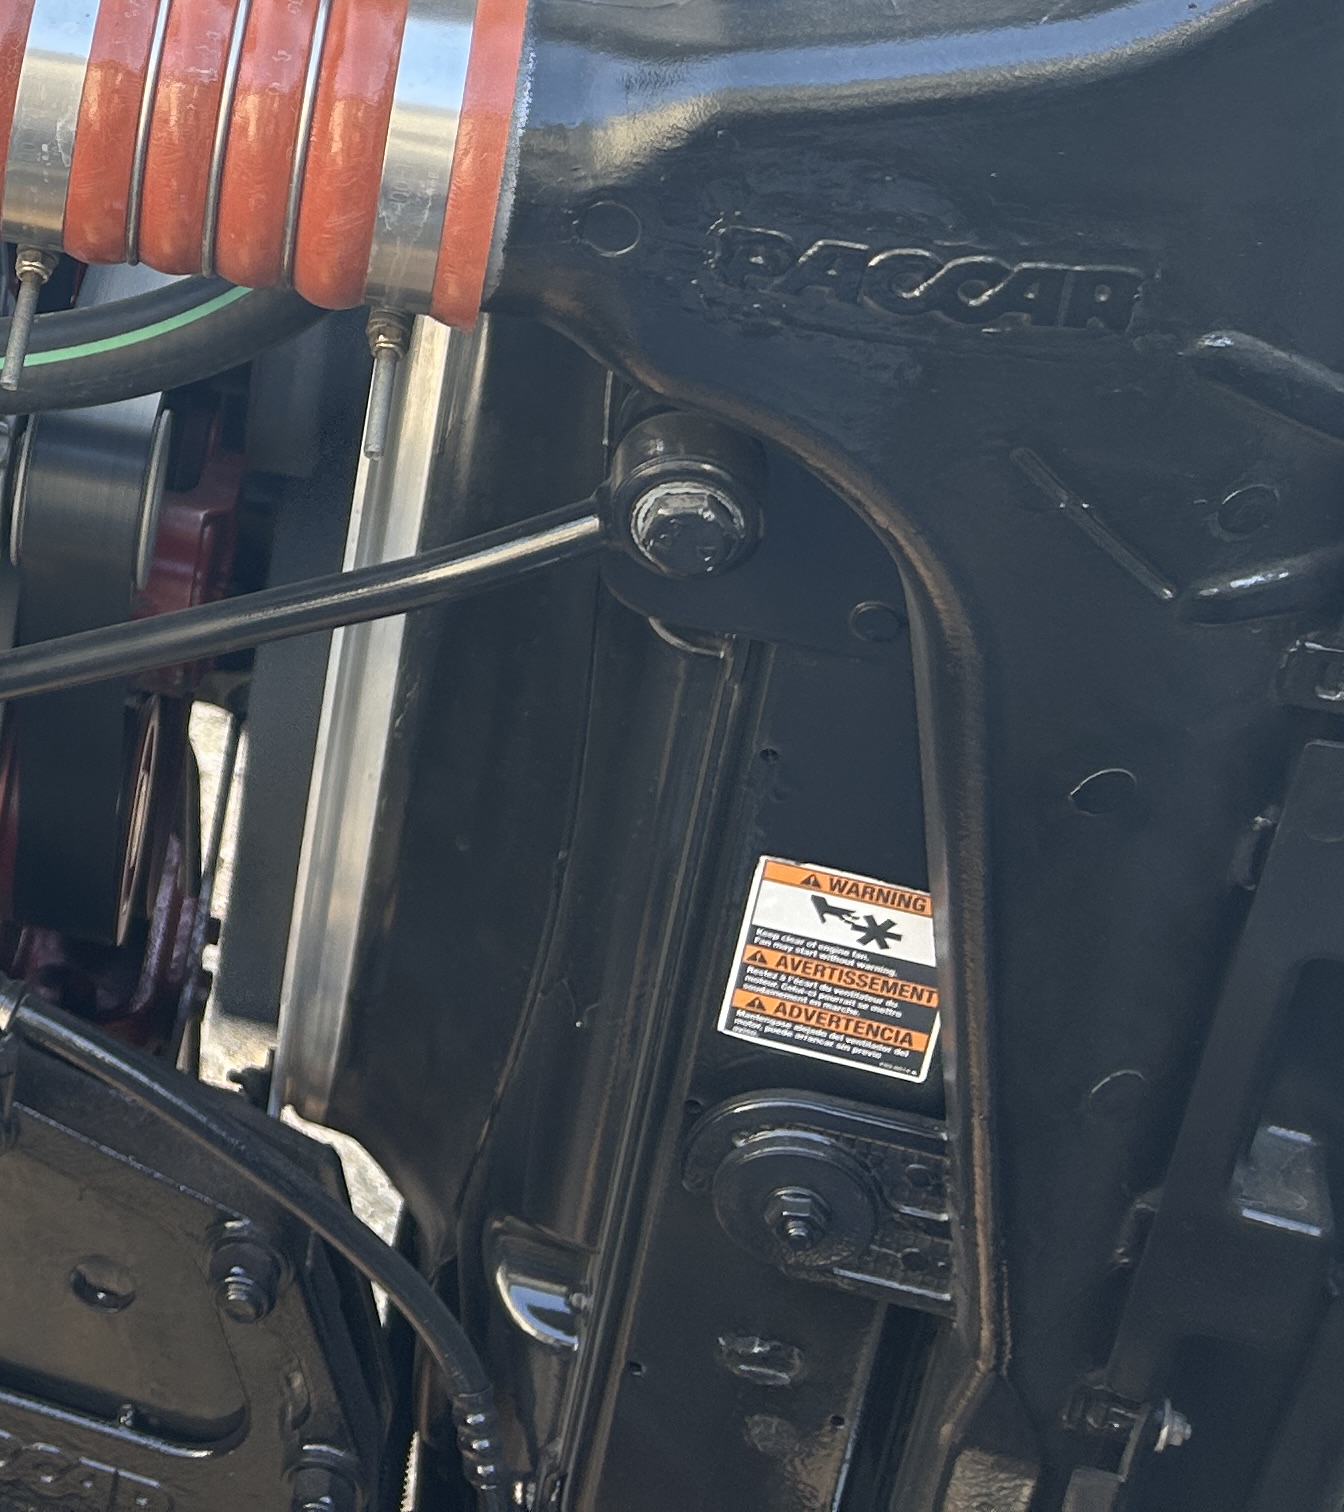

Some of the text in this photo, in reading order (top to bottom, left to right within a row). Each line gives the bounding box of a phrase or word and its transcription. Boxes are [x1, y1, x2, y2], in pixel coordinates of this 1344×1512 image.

[708, 216, 1158, 334] PACCAR
[828, 876, 927, 914] WARNING
[754, 936, 772, 949] Fan
[773, 942, 793, 954] may
[794, 946, 818, 959] start
[819, 951, 856, 968] without
[755, 927, 780, 942] Keep
[781, 933, 805, 947] clear
[806, 939, 817, 950] of
[818, 942, 851, 960] engine
[776, 954, 938, 1004] AVERTISSEMENT
[773, 1001, 914, 1047] ADVERTENCIA
